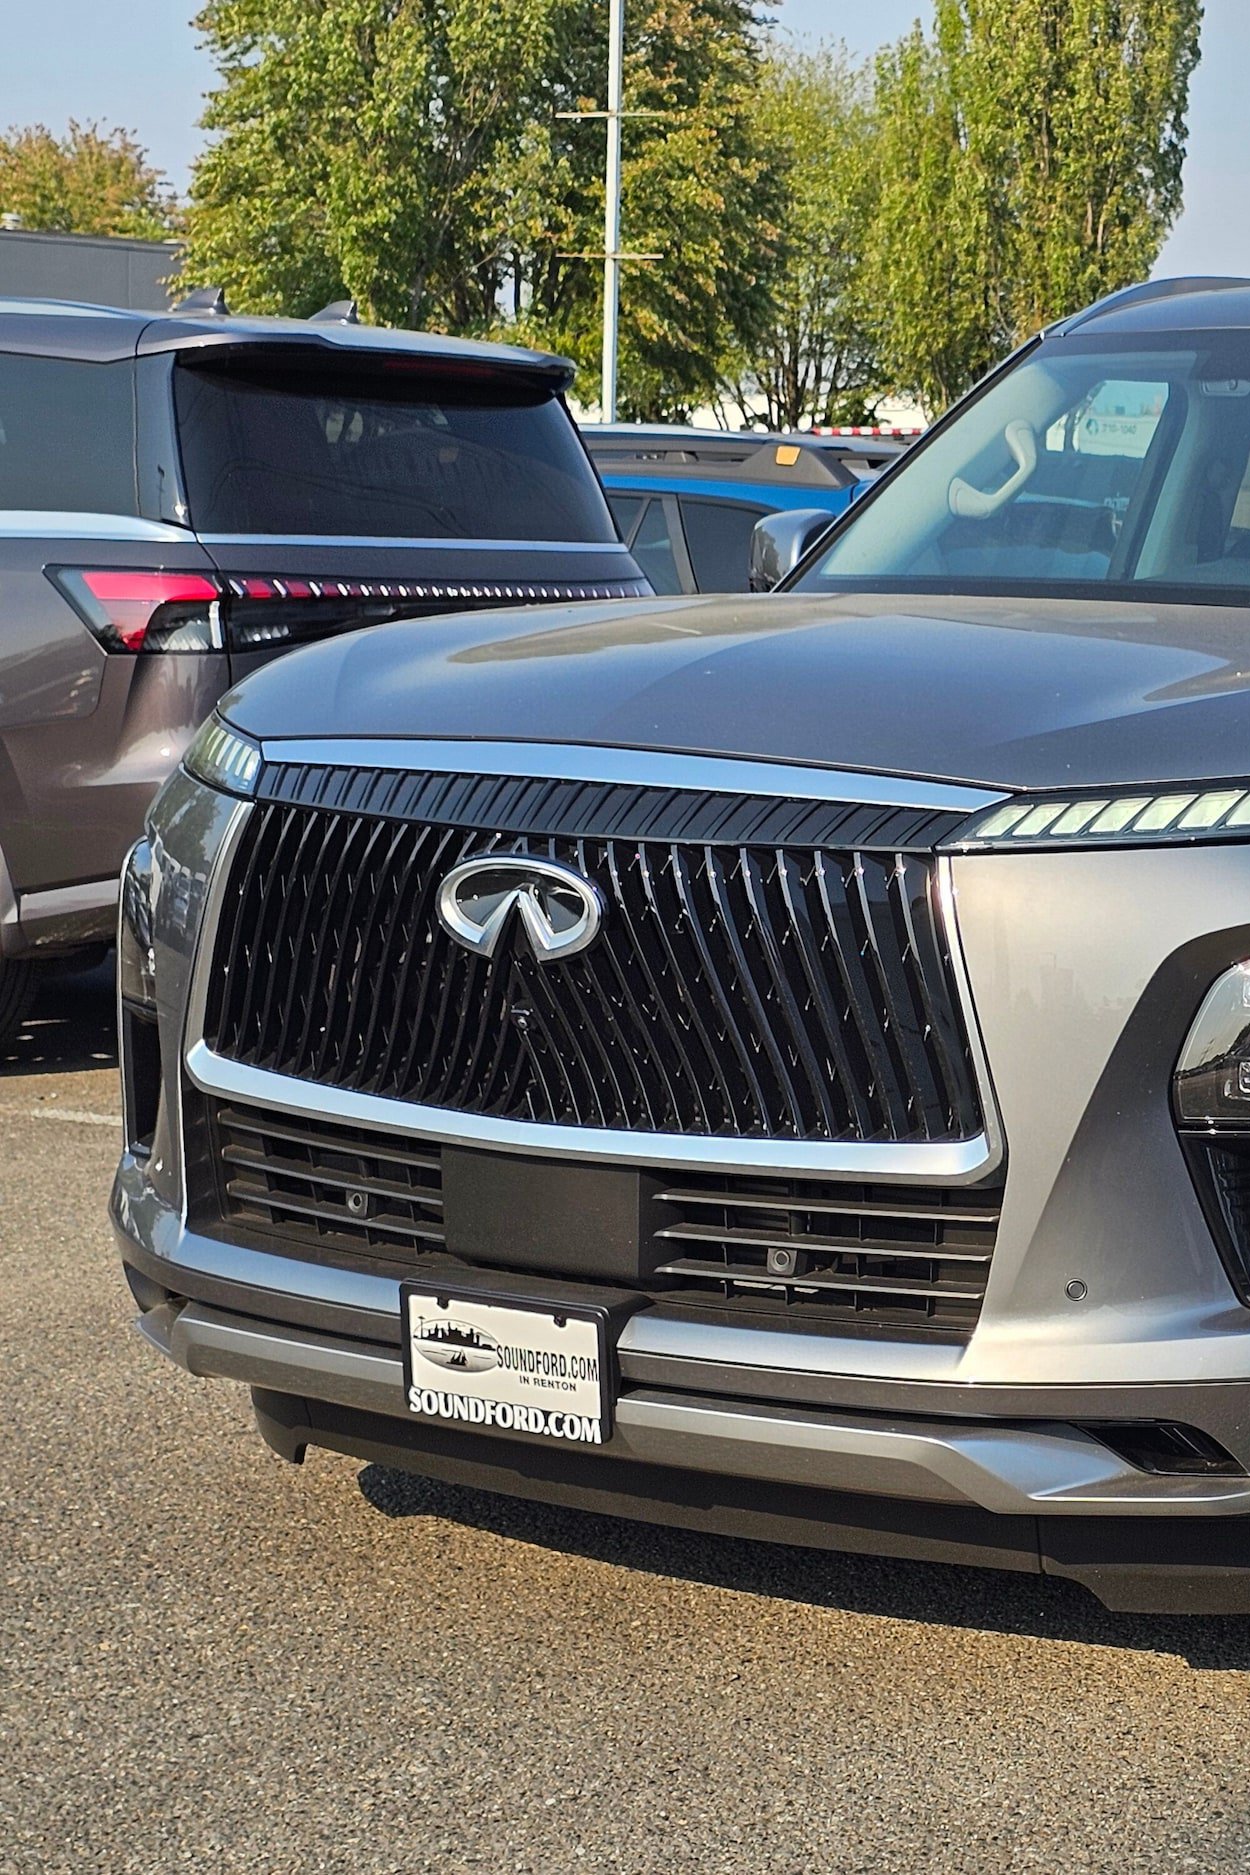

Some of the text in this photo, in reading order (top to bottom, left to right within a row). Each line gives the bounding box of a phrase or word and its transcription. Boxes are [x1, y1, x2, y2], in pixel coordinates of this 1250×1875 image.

[496, 1344, 600, 1382] SOUNDFORD.COM
[519, 1374, 577, 1392] IN RENTON
[408, 1386, 602, 1445] SOUNDFORD.COM
